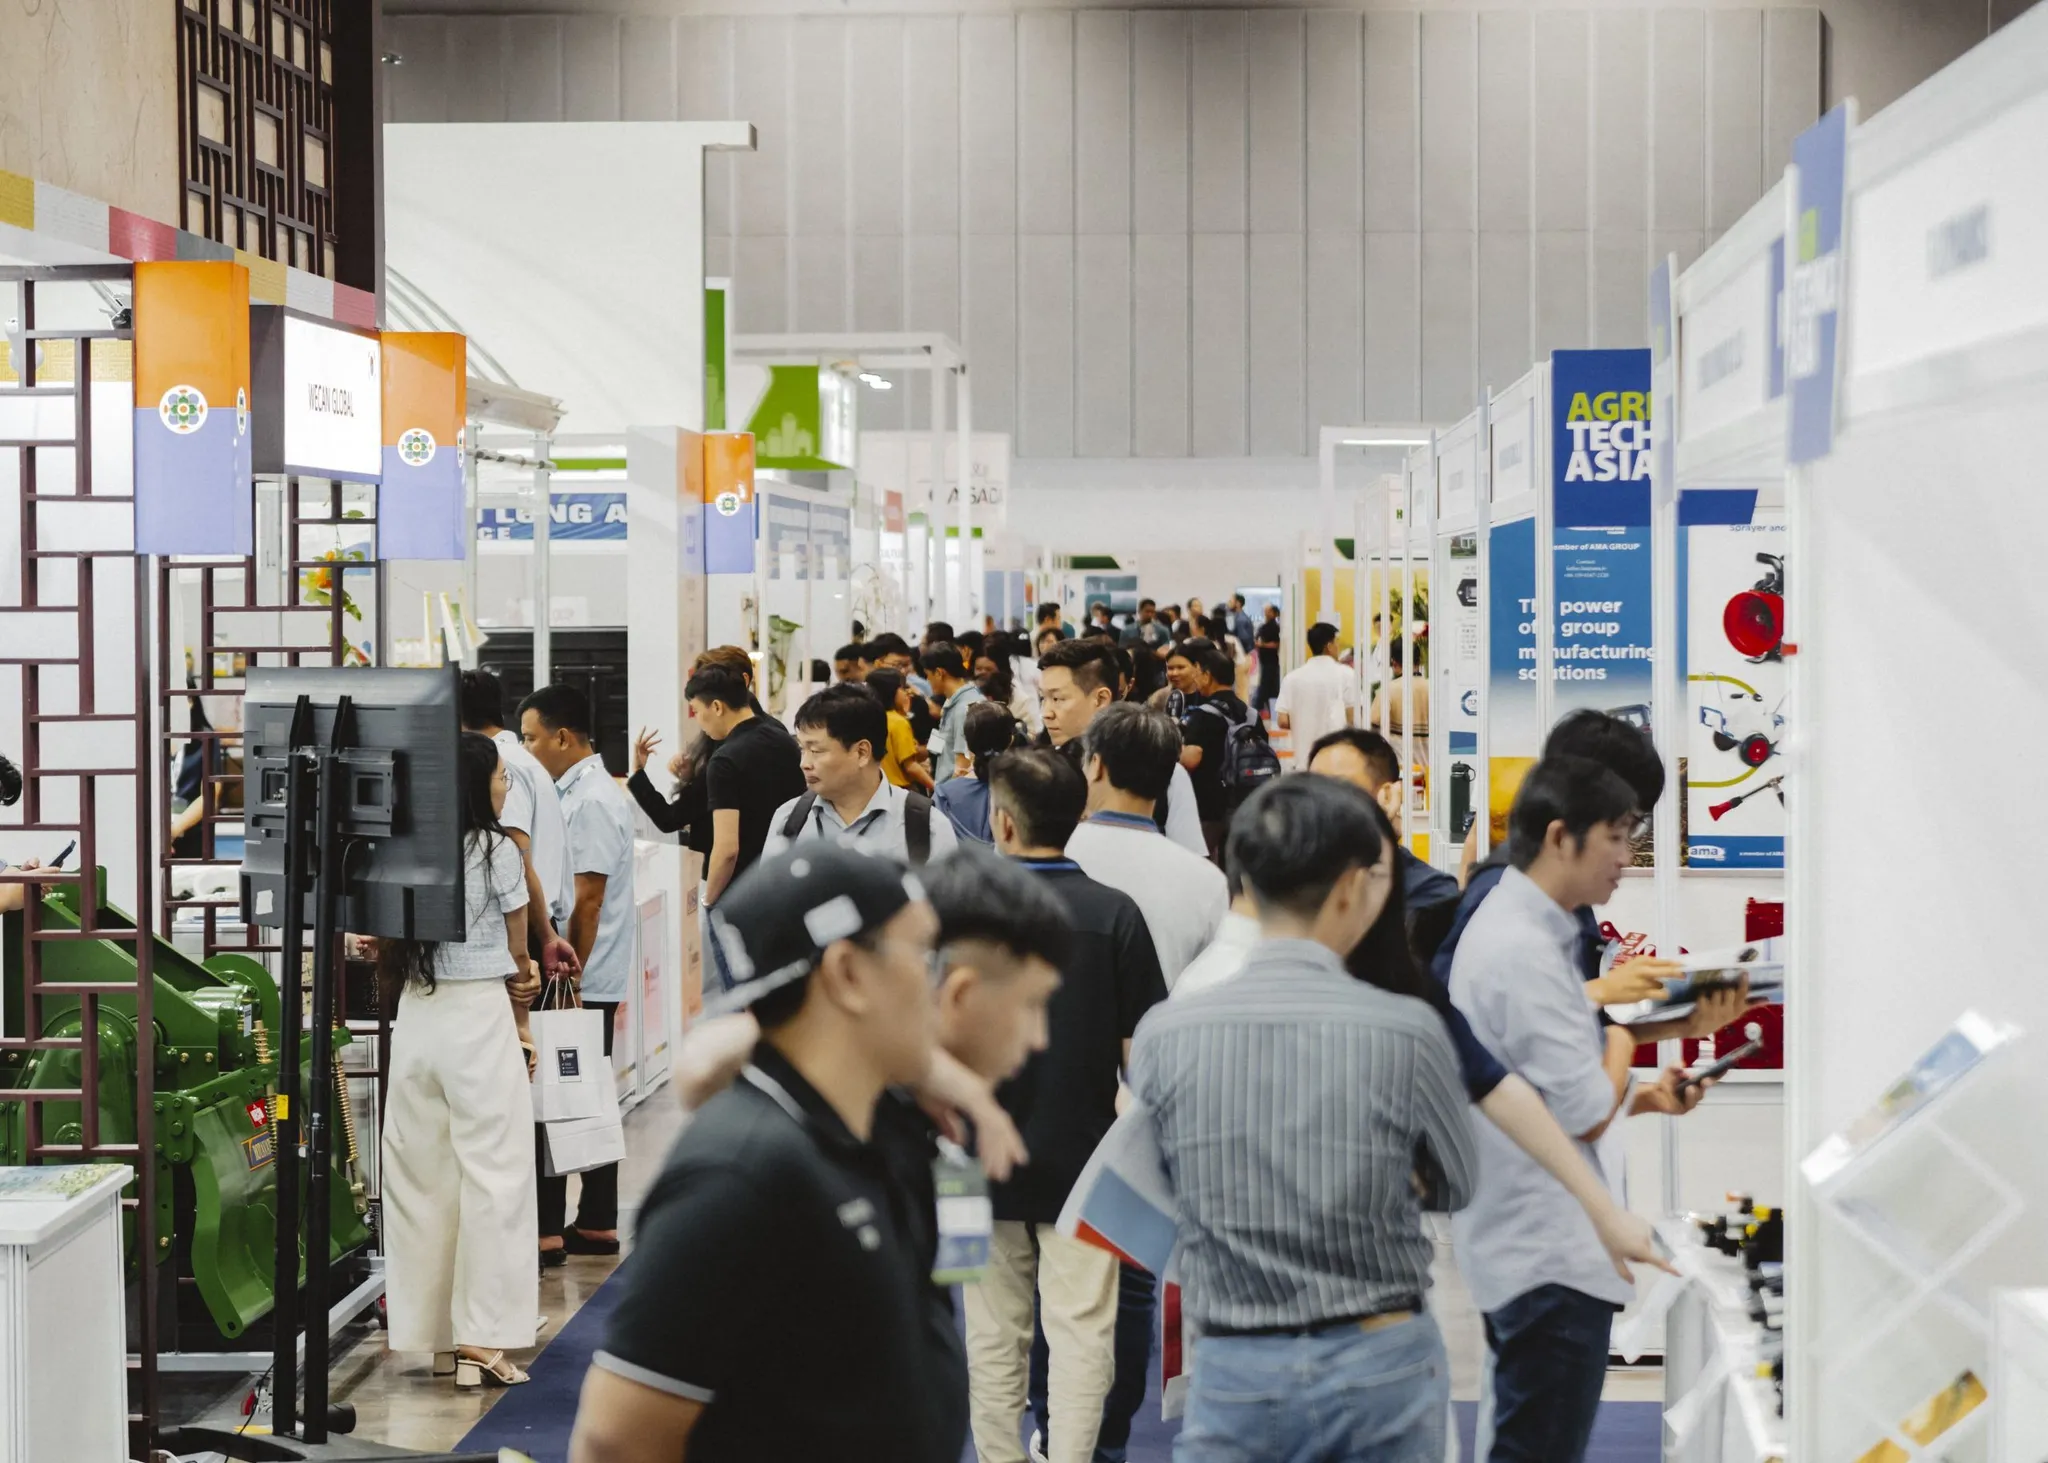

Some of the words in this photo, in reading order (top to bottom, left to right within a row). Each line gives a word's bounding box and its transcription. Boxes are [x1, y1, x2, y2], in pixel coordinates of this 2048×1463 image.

[308, 383, 331, 412] WECAN
[1564, 450, 1656, 483] ASIA
[1560, 600, 1623, 617] power
[1561, 621, 1620, 637] group
